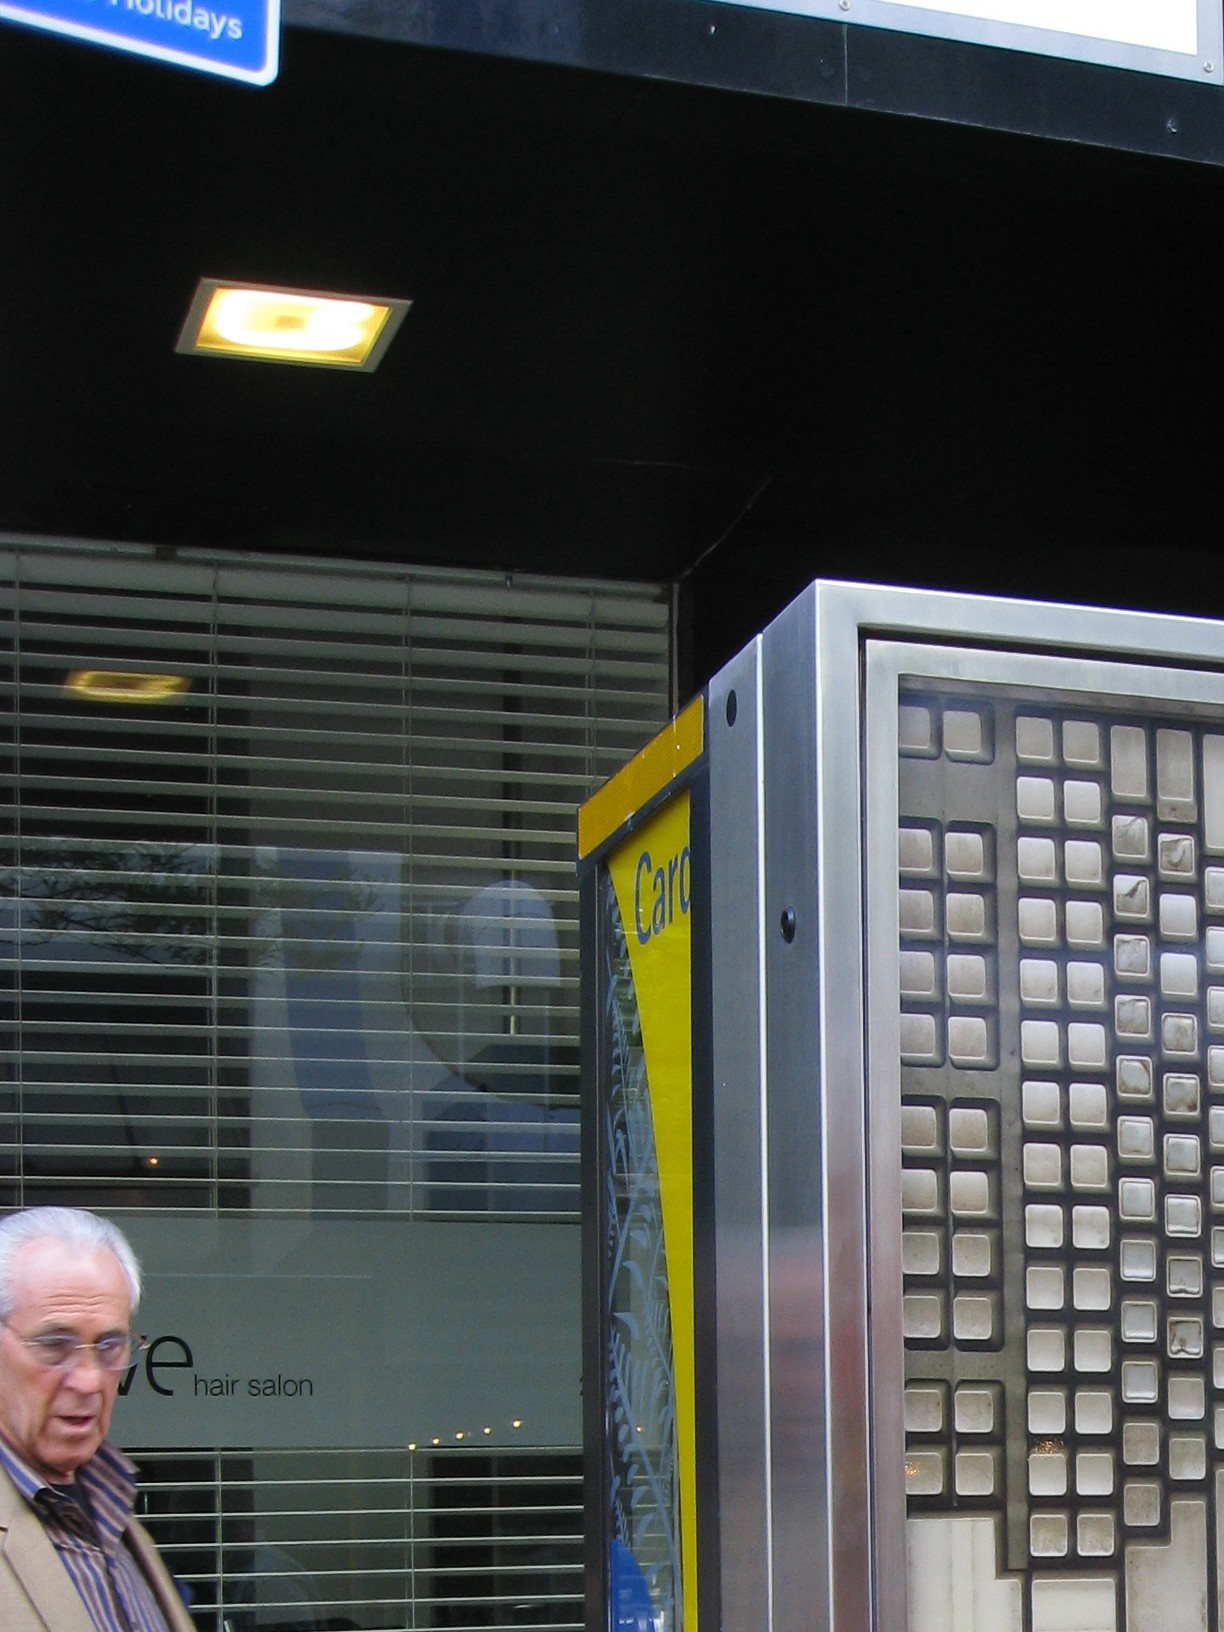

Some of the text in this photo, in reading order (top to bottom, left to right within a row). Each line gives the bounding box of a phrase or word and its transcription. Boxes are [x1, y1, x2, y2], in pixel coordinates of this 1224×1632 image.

[110, 0, 243, 40] olidays
[194, 1374, 240, 1397] hair
[248, 1374, 313, 1397] salon
